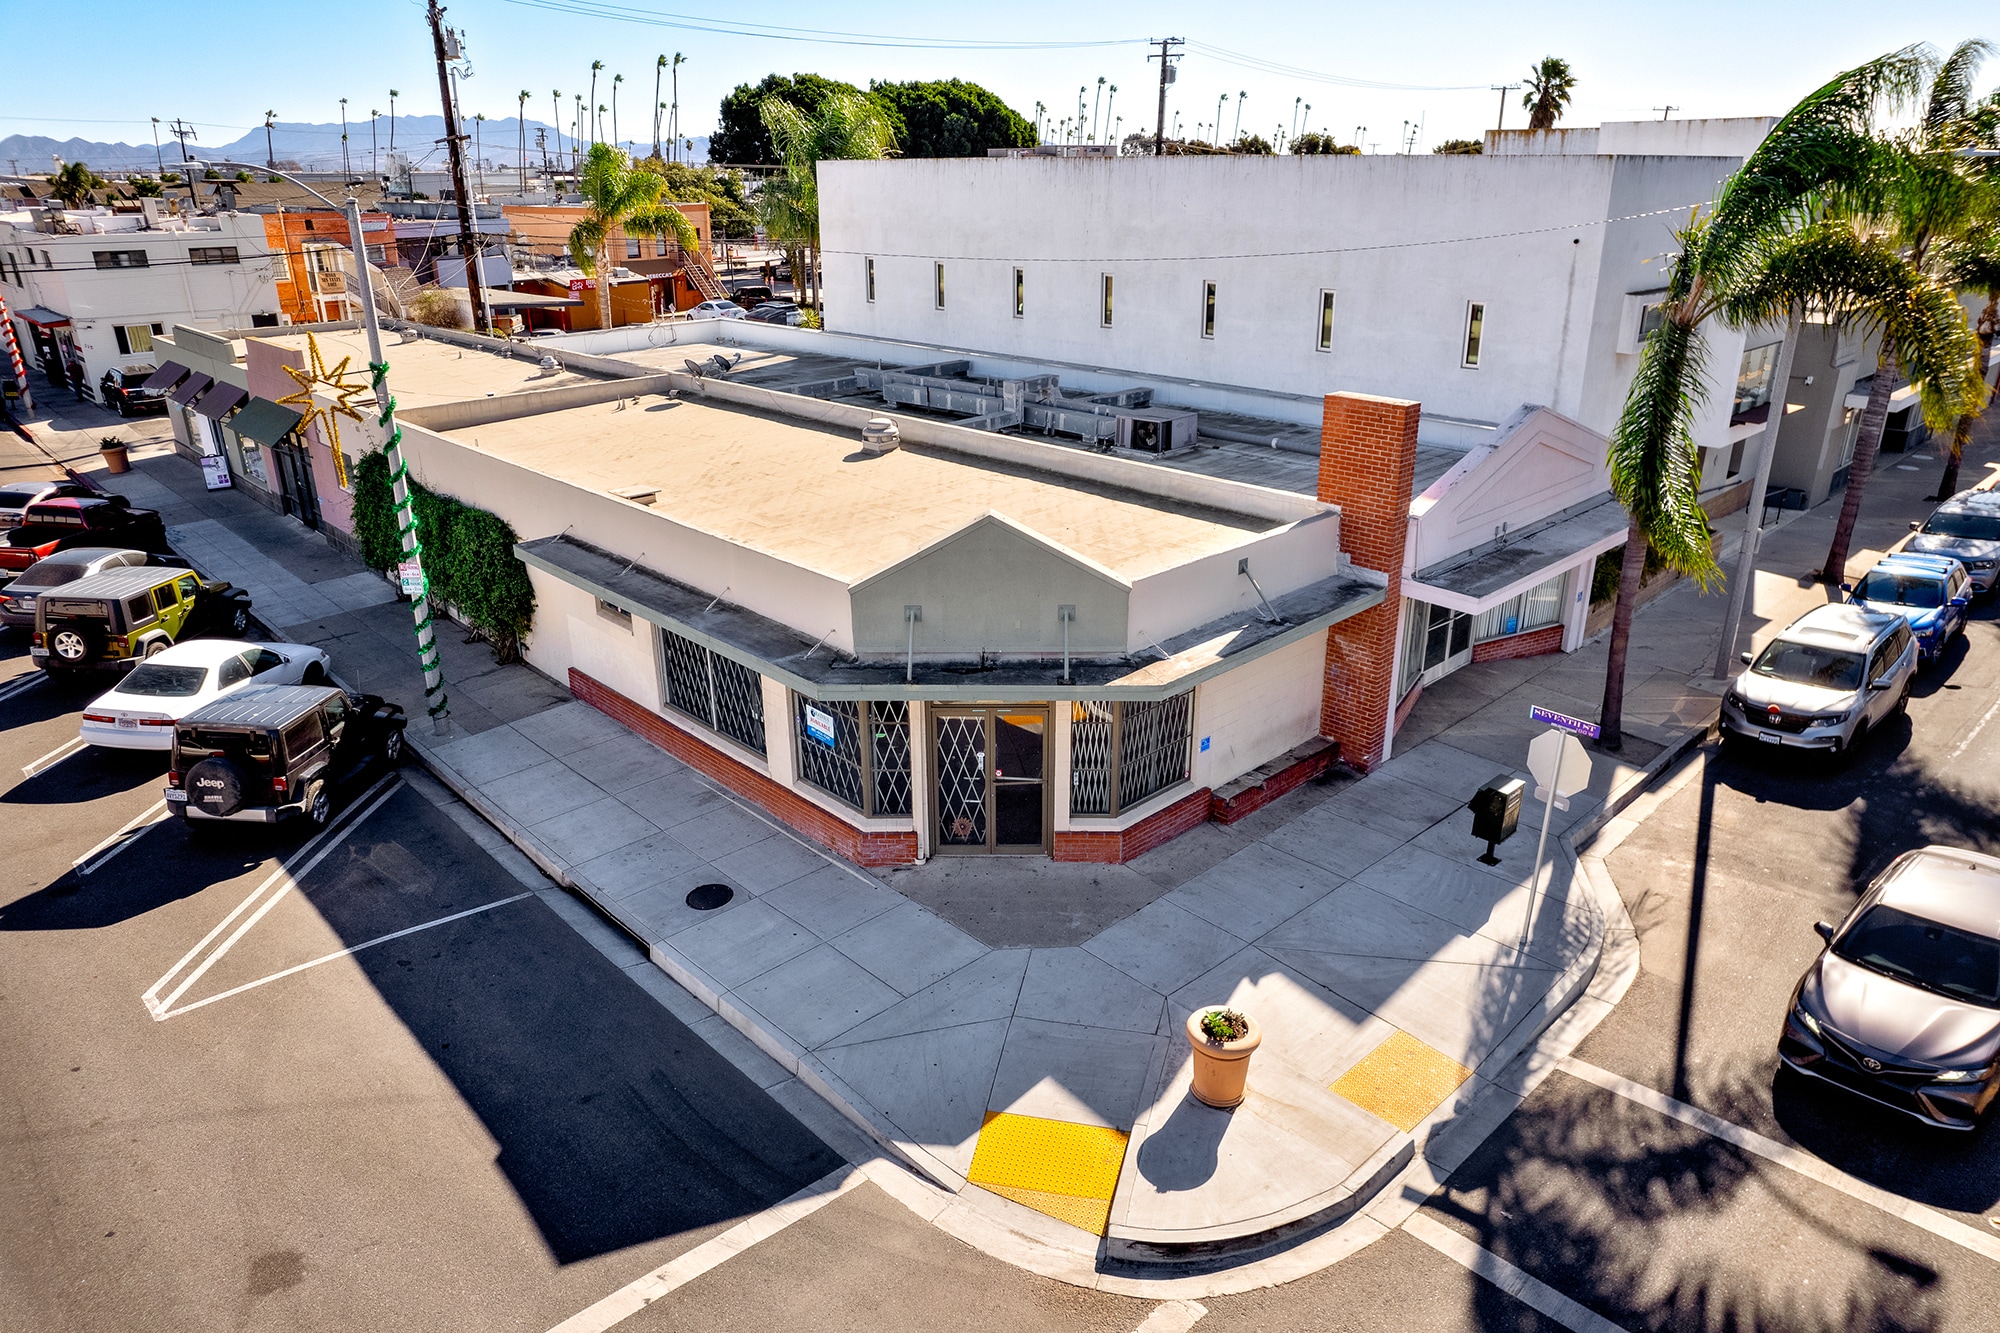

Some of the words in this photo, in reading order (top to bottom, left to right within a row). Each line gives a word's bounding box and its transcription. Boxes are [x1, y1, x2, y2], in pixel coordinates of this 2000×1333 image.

[810, 717, 831, 732] AVAILABLE
[1534, 708, 1581, 728] SEVENTH
[1582, 723, 1596, 732] ST
[196, 777, 225, 789] Jeep
